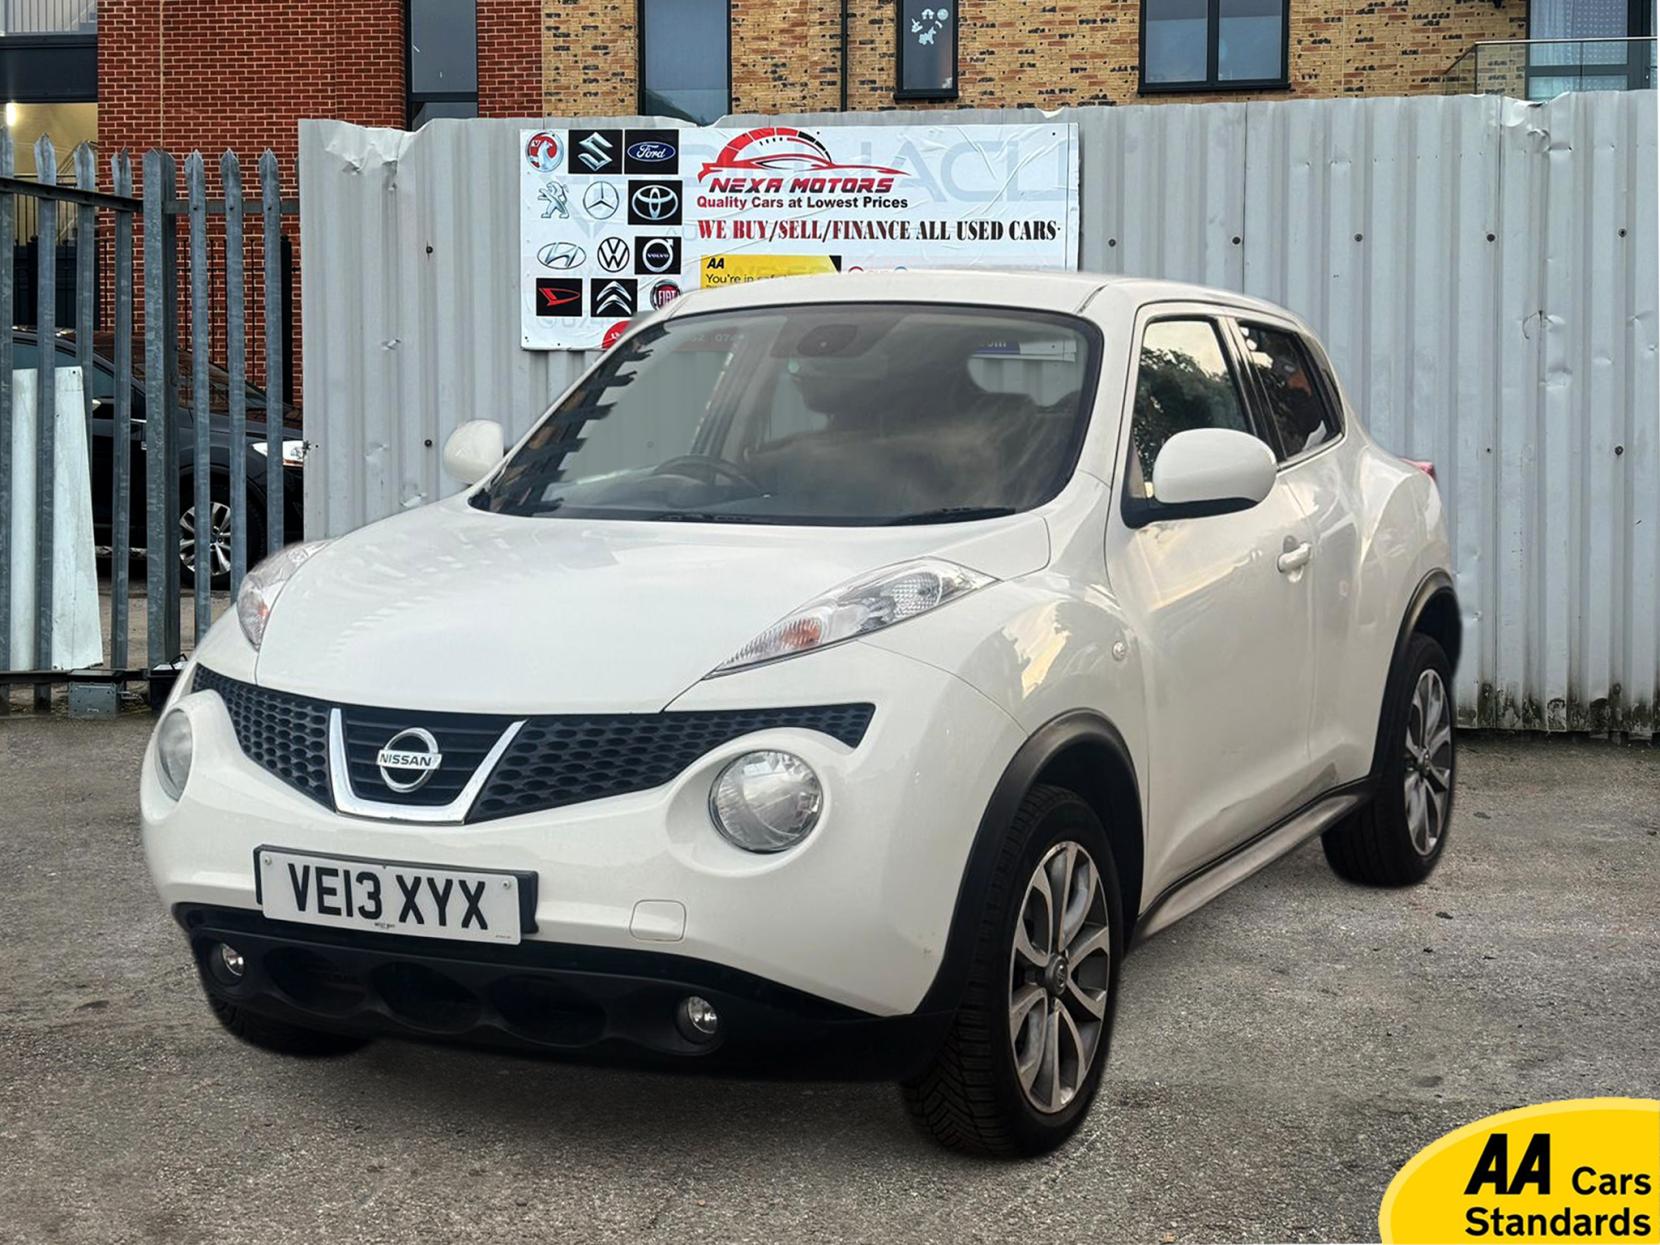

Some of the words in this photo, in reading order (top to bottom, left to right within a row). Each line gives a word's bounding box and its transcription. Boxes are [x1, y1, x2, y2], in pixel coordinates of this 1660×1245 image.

[636, 144, 667, 158] Ford
[709, 178, 784, 193] NEXA
[789, 178, 893, 193] MOTORS
[697, 196, 747, 210] Quality
[751, 196, 783, 208] Cars
[788, 197, 802, 208] at
[807, 197, 858, 208] Lowest
[863, 196, 908, 208] Prices
[698, 220, 726, 239] WE
[733, 220, 910, 243] BUY/SELL/FINANCE
[916, 221, 950, 240] ALL
[956, 221, 1003, 240] USED
[1009, 220, 1056, 240] CARS
[647, 251, 669, 259] VOLVO
[707, 258, 725, 269] AA
[706, 273, 741, 284] You're
[658, 290, 676, 304] FIAT
[379, 752, 433, 767] NISSAN
[288, 863, 382, 920] VE13
[396, 874, 488, 930] XYX
